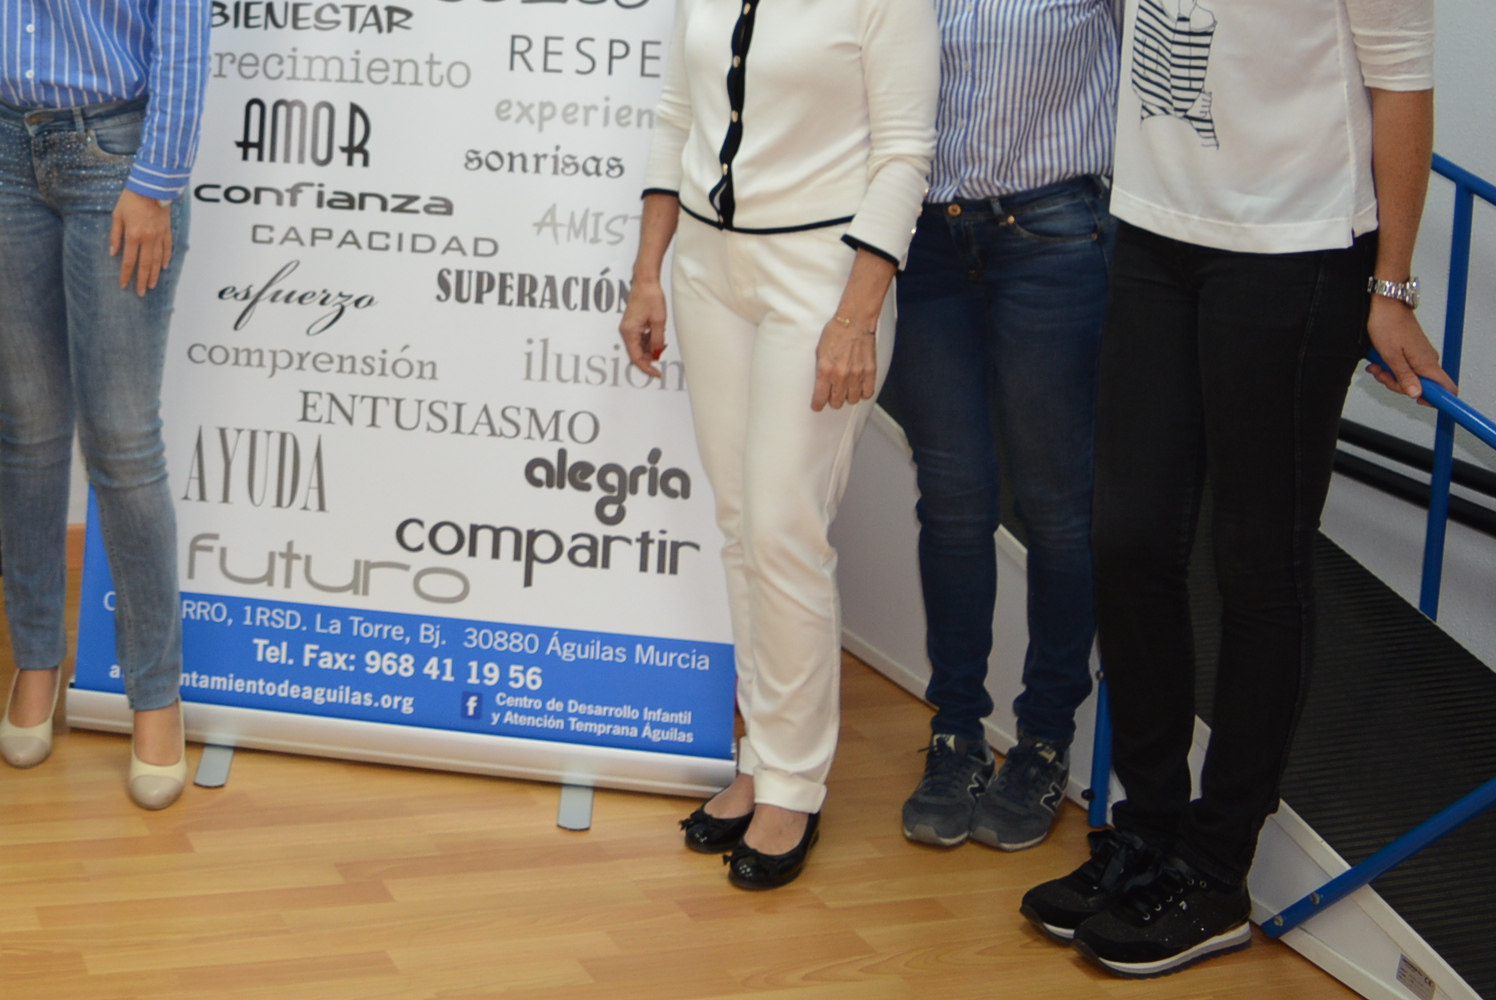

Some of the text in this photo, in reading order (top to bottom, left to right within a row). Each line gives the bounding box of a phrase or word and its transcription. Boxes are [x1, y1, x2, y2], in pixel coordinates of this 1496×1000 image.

[210, 0, 414, 34] BIENESTAR
[208, 47, 472, 89] recimiento
[508, 34, 663, 78] RESPE
[234, 98, 372, 168] AMOR
[494, 96, 655, 133] experien
[464, 144, 626, 179] sonrisas
[194, 182, 455, 216] confianza
[251, 224, 500, 258] CAPACIDAD
[533, 202, 643, 246] AMIS
[217, 259, 379, 337] esfuerzo
[187, 342, 439, 381] comprensión
[297, 389, 600, 445] ENTUSIASMO
[181, 424, 329, 514] AYUDA
[524, 447, 691, 526] alegría
[187, 532, 471, 604] futuro
[395, 517, 700, 588] compartir
[242, 605, 307, 632] 1RSD.
[315, 612, 342, 634] La
[349, 616, 411, 644] Torre,
[419, 623, 447, 649] Bj.
[462, 627, 540, 654] 30880
[545, 631, 627, 662] Águilas
[634, 643, 710, 671] Murcia
[252, 637, 543, 691] Tel. Fax: 968 41 19 56
[491, 711, 694, 744] y Atención Temprana Águilas
[495, 691, 692, 725] Centro de Desarrollo Infantil
